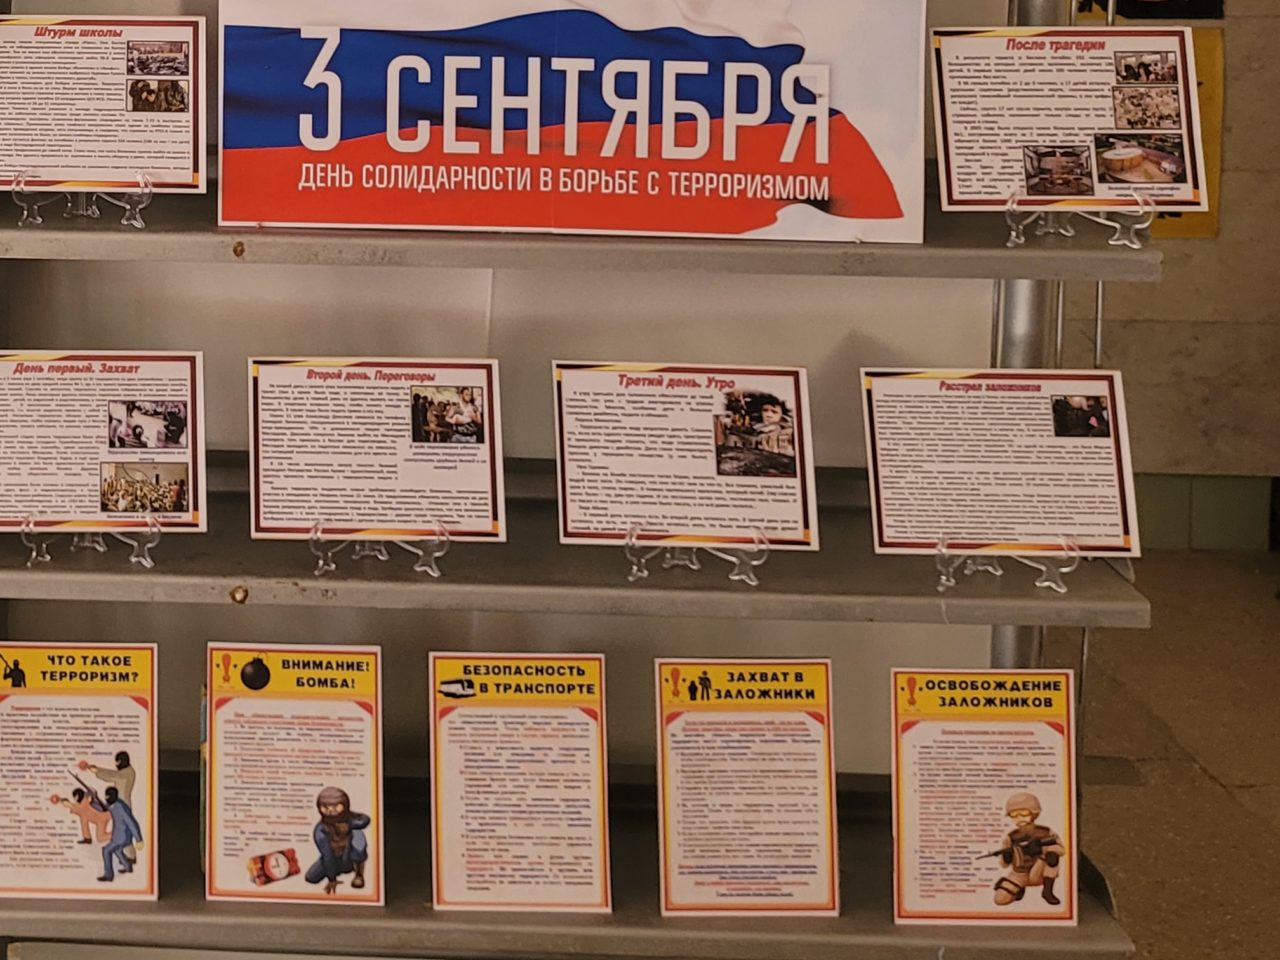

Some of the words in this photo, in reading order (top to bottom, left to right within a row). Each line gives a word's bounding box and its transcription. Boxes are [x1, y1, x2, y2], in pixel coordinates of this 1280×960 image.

[34, 26, 77, 39] Штурм
[79, 28, 123, 38] школы
[1006, 38, 1046, 50] После
[1049, 41, 1106, 53] трагедии
[298, 26, 343, 151] 3
[386, 54, 831, 164] СЕНТЯБРЯ
[298, 163, 353, 192] ДЕНЬ
[362, 165, 531, 194] СОЛИДАРНОСТИ
[541, 169, 552, 191] В
[558, 169, 638, 195] БОРЬБЕ
[647, 172, 660, 196] С
[668, 171, 830, 202] ТЕРРОРИЗМОМ
[13, 363, 44, 374] День
[47, 363, 95, 375] первый.
[100, 363, 140, 374] Захват
[306, 368, 342, 381] Второй
[344, 372, 371, 382] день.
[374, 370, 436, 383] Переговоры
[618, 374, 663, 388] Третий
[666, 377, 702, 390] день.
[705, 376, 736, 392] Утро
[939, 380, 982, 393] Расстрел
[985, 382, 1042, 393] заложников
[47, 655, 76, 666] ЧТО
[82, 655, 132, 666] ТАКОЕ
[281, 659, 370, 672] ВНИМАНИЕ!
[40, 670, 140, 682] ТЕРРОРИЗМ?
[463, 664, 586, 676] БЕЗОПАСНОСТЬ
[296, 677, 356, 689] БОМБА!
[727, 672, 788, 682] ЗАХВАТ
[794, 672, 804, 682] В
[480, 682, 489, 694] В
[493, 683, 595, 694] ТРАНСПОРТЕ
[924, 680, 1062, 692] ОСВОБОЖДЕНИЕ
[714, 688, 816, 700] ЗАЛОЖНИКИ
[938, 696, 1054, 708] ЗАЛОЖНИКОВ
